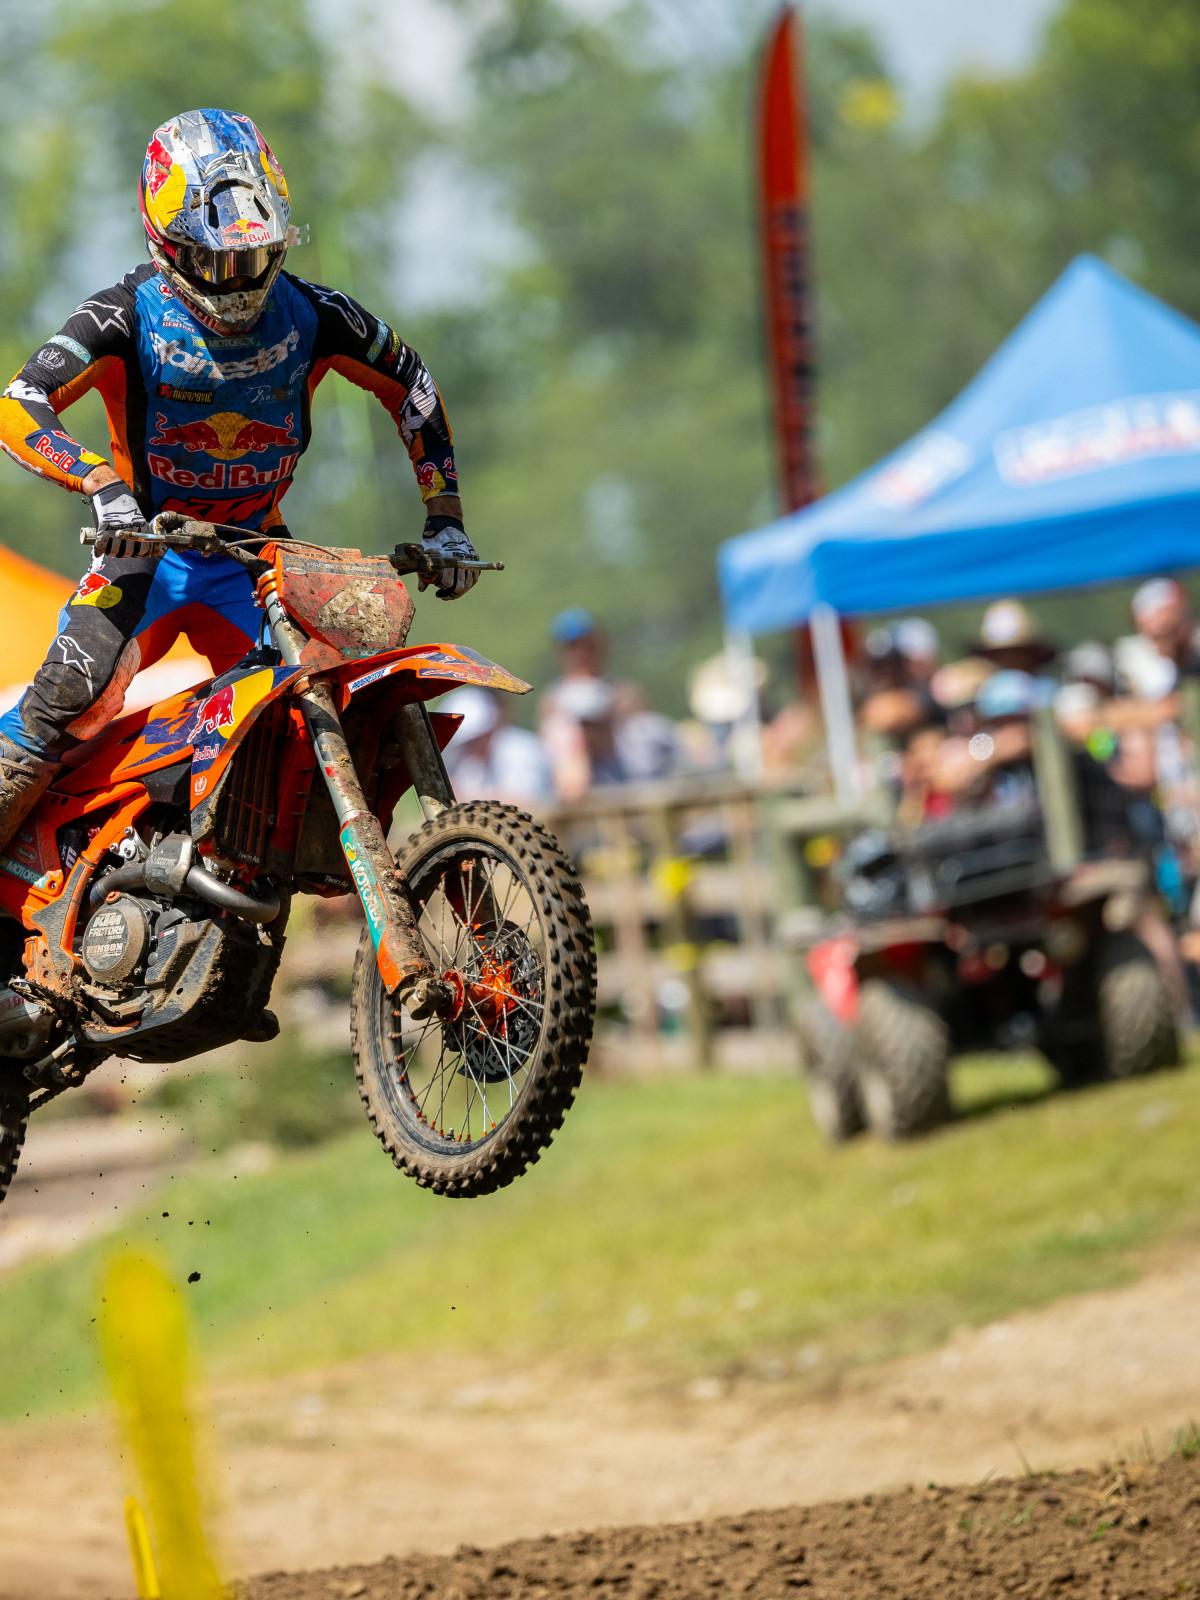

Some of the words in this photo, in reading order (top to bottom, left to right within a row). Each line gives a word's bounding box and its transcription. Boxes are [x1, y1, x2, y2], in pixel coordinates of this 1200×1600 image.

[222, 235, 248, 247] Red
[249, 230, 271, 244] Bull
[162, 321, 196, 334] RENTHAL
[207, 337, 255, 349] MOTOREX
[246, 384, 295, 404] PARASE
[35, 434, 66, 468] Red
[148, 452, 226, 490] Red
[228, 452, 298, 490] Bull
[159, 489, 275, 525] KTM
[192, 748, 207, 763] Red
[205, 743, 220, 760] Bull
[351, 859, 383, 928] MOTOREX
[92, 912, 123, 928] KTM
[88, 924, 125, 938] FACTORY
